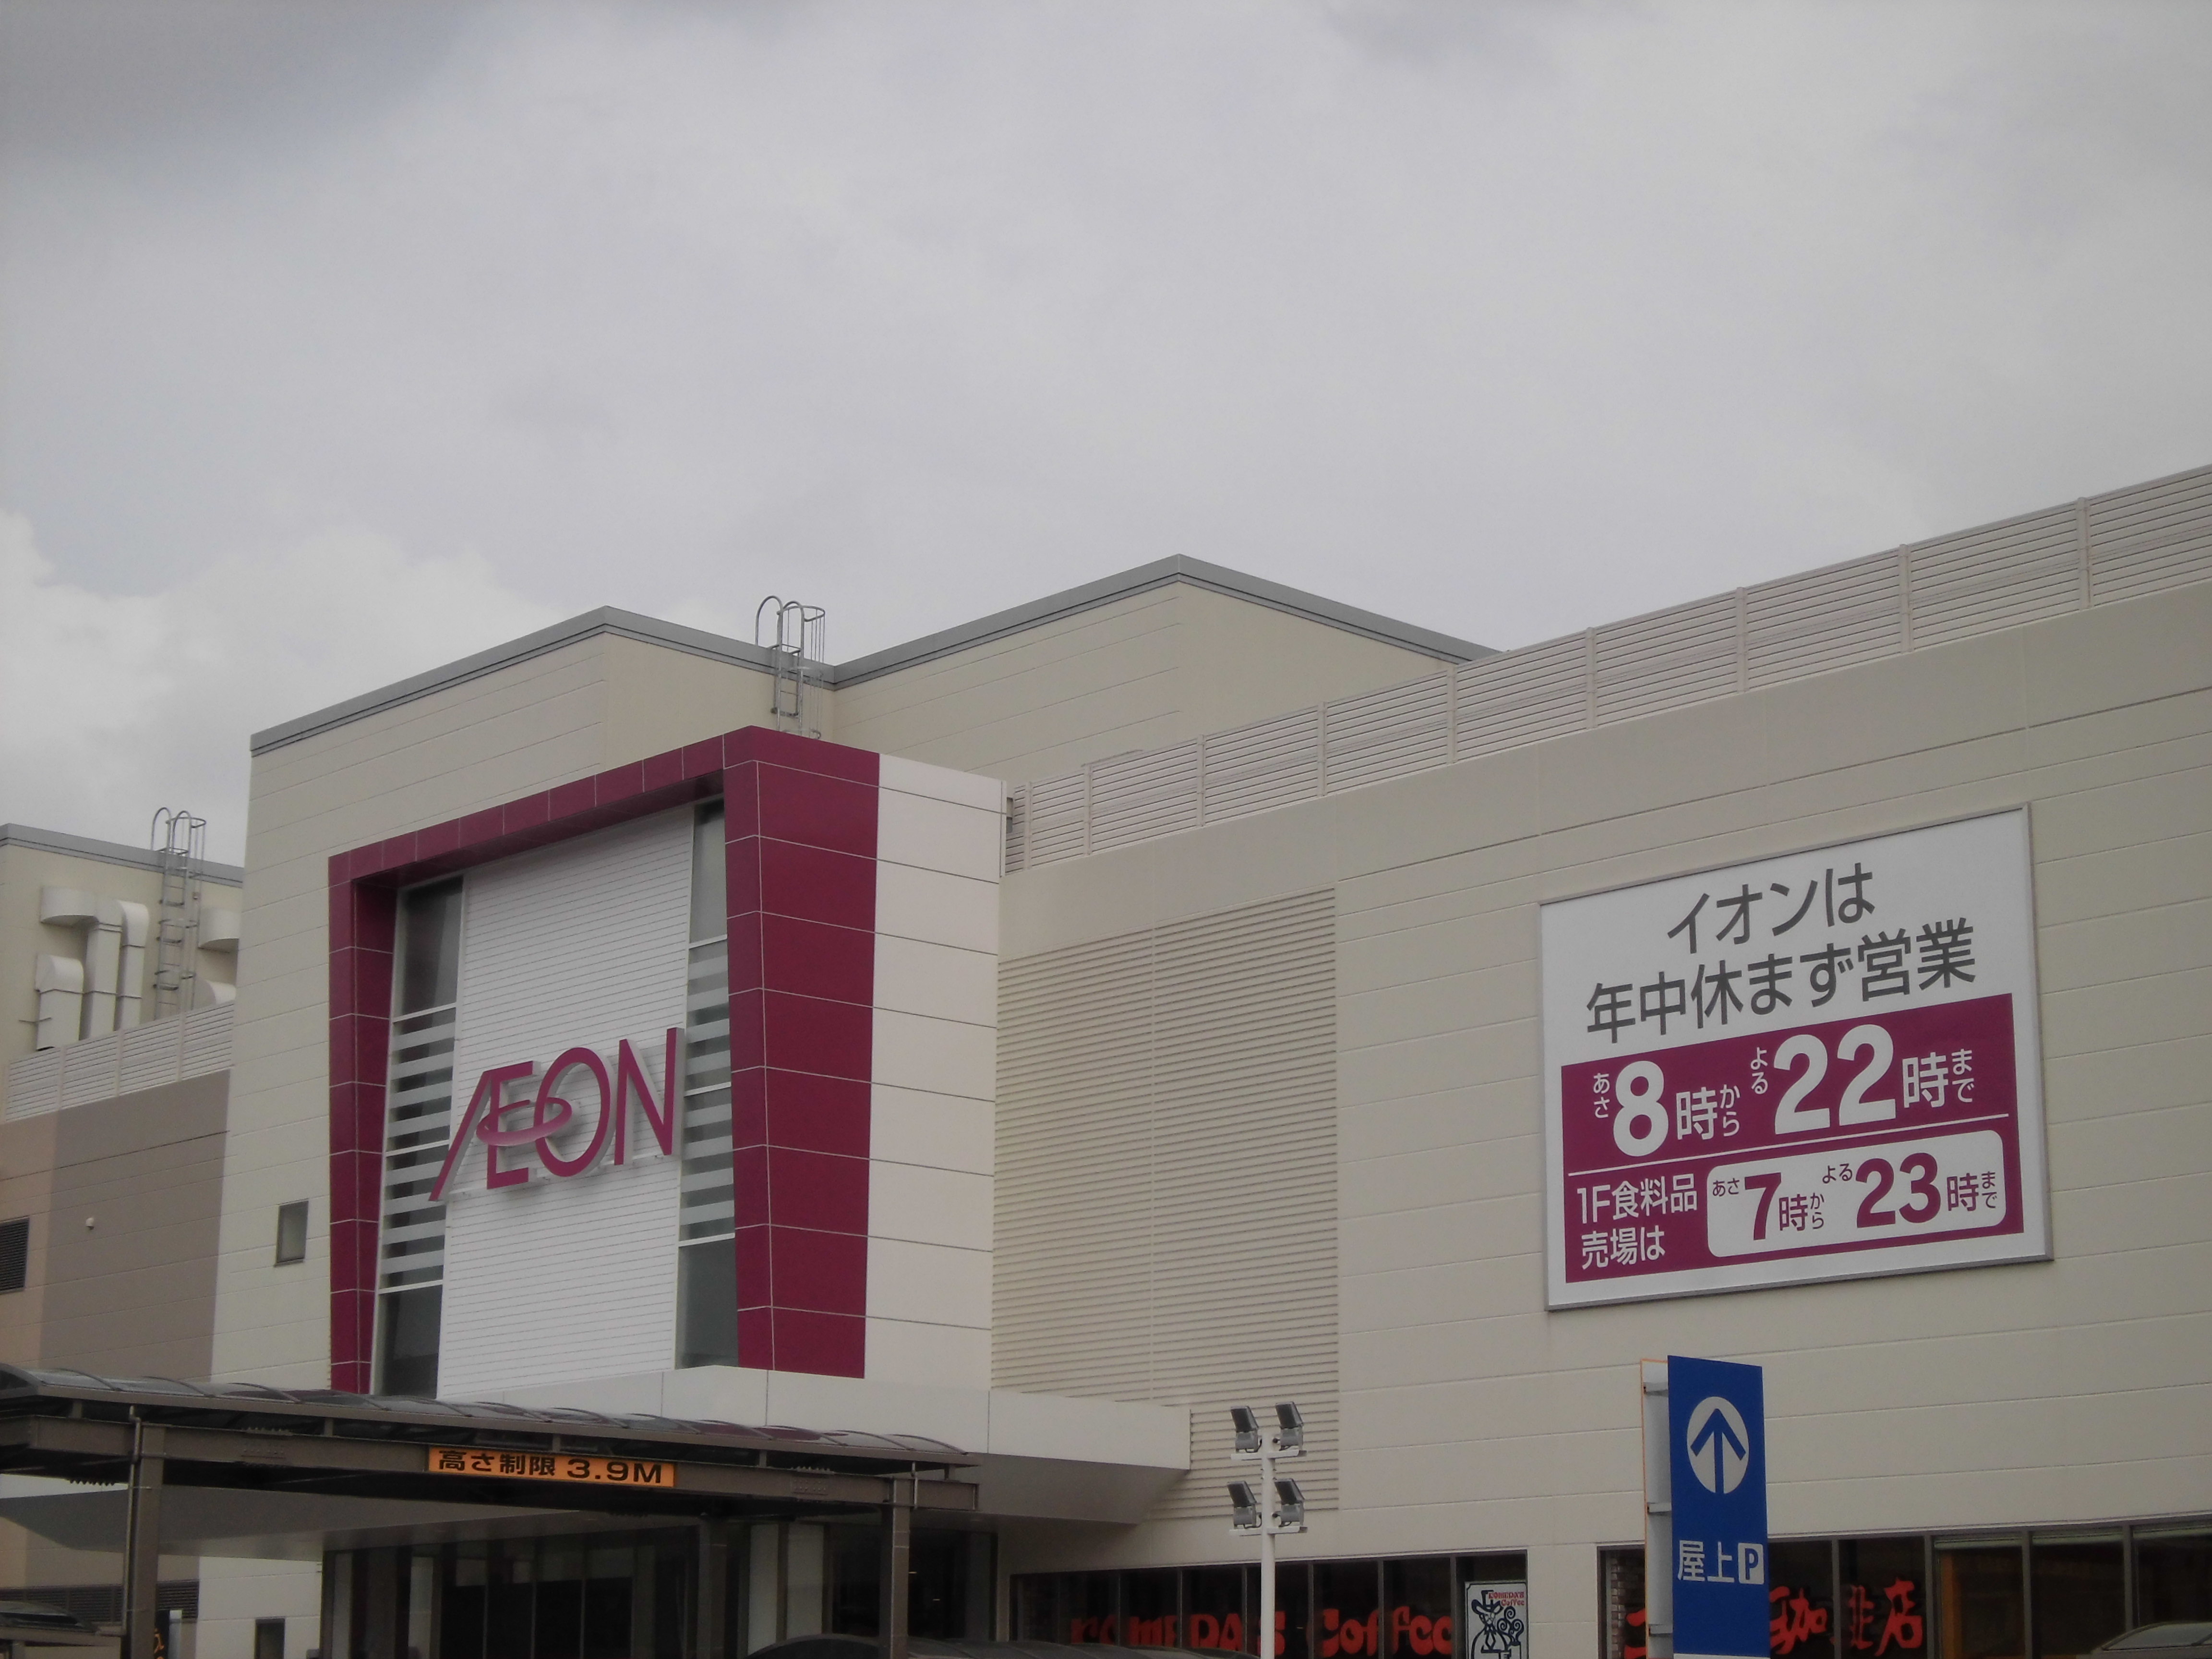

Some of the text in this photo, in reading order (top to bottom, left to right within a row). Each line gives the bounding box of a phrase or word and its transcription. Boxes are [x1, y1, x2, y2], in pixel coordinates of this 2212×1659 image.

[1667, 863, 1875, 954] イオンは
[1586, 917, 1975, 1043] 年中休まず営業
[1576, 1173, 1698, 1224] 1F食料品
[1581, 1225, 1666, 1270] 売場は
[438, 1450, 662, 1484] 高さ制限 3.9M
